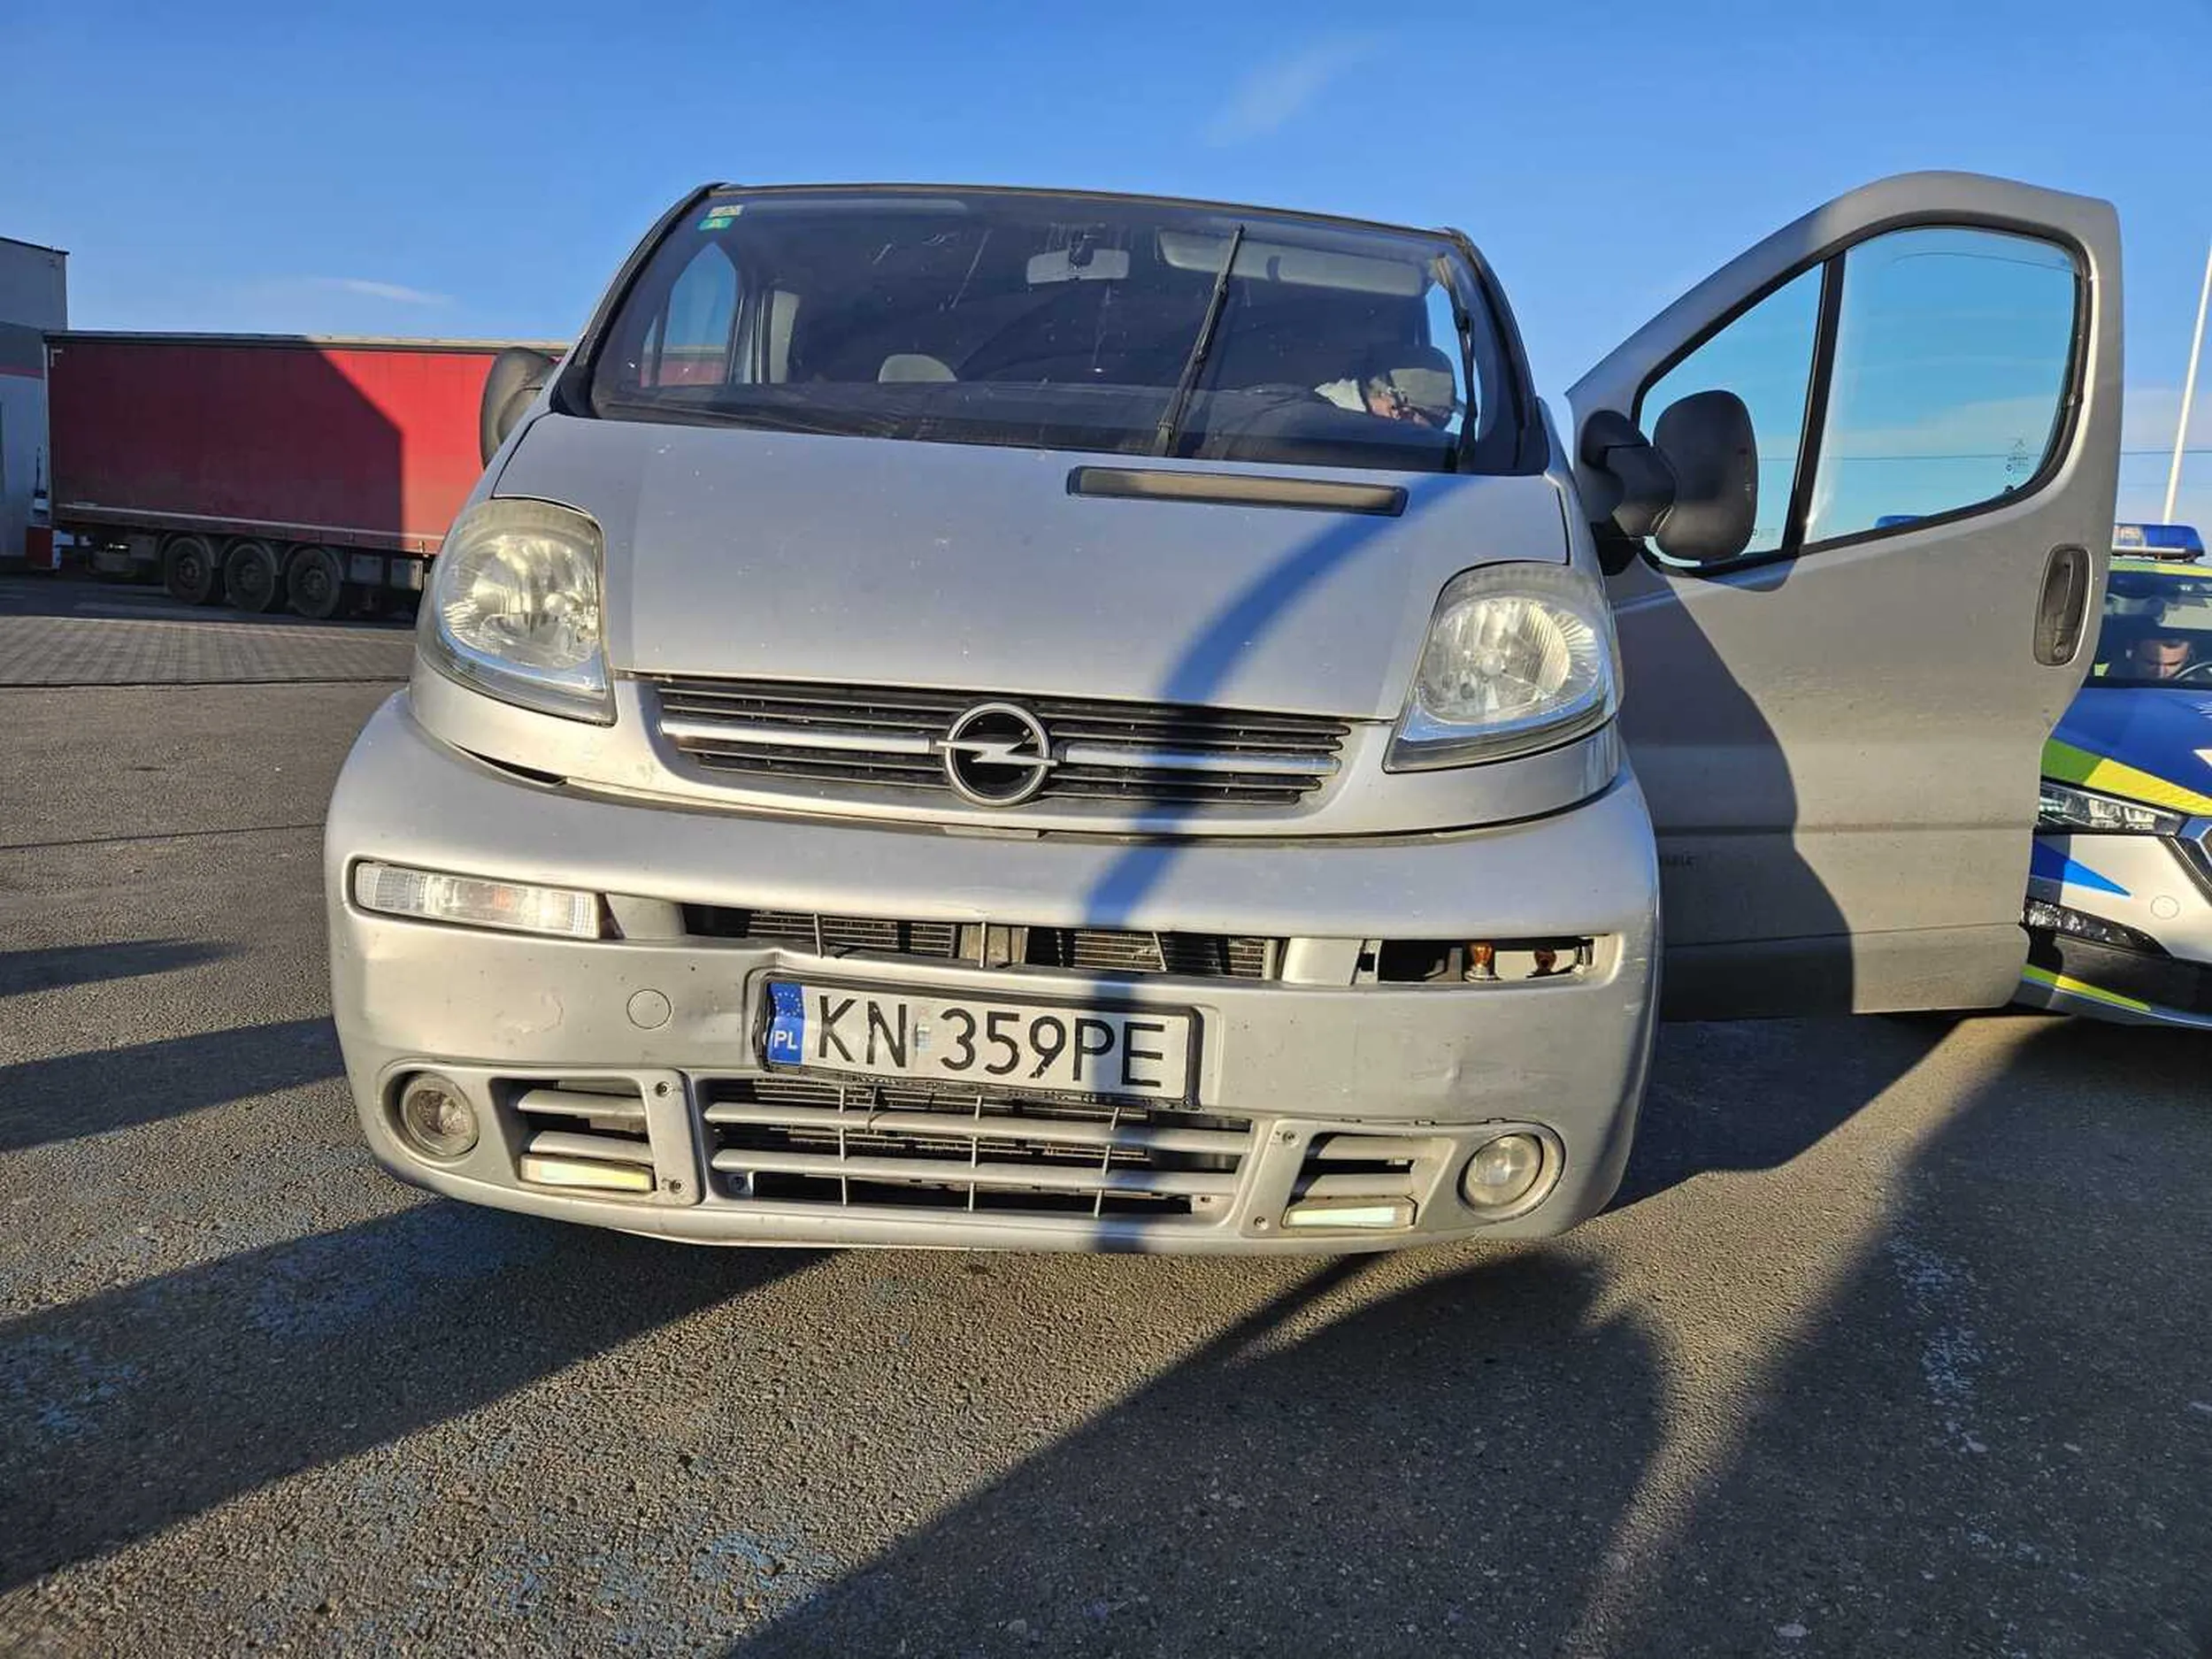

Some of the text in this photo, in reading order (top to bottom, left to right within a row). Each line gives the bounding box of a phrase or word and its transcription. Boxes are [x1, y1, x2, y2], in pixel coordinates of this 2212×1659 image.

[773, 1030, 798, 1050] PL
[818, 995, 1166, 1088] KN 359PE
